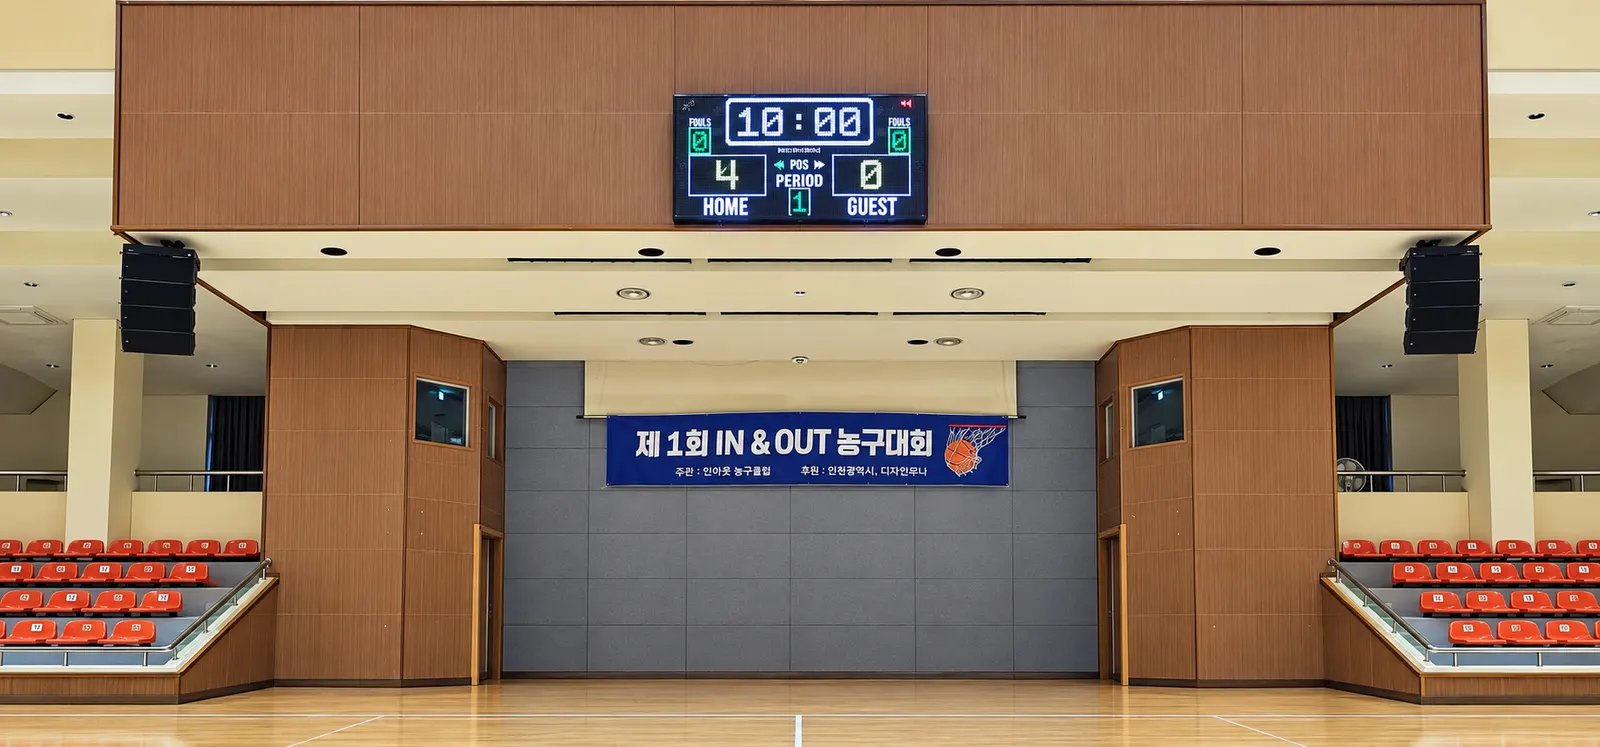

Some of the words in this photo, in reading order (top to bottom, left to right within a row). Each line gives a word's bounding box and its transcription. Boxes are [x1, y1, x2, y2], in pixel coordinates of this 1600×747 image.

[688, 117, 712, 127] FOULS
[736, 106, 862, 137] 10:00
[888, 117, 911, 127] FOULS
[692, 130, 707, 151] 0
[891, 130, 907, 151] 0
[789, 158, 809, 171] POS
[715, 159, 739, 190] 4
[775, 173, 824, 188] PERIOD
[860, 159, 882, 190] 0
[703, 197, 749, 216] HOME
[793, 191, 807, 213] 1
[847, 197, 898, 216] GUEST
[635, 430, 660, 458] 제
[666, 429, 708, 457] 1회
[715, 430, 745, 456] IN
[750, 430, 771, 455] &
[774, 429, 832, 455] OUT
[836, 428, 933, 457] 농구대회
[675, 467, 694, 477] 주관
[703, 466, 731, 477] 인아웃
[800, 465, 819, 476] 후원
